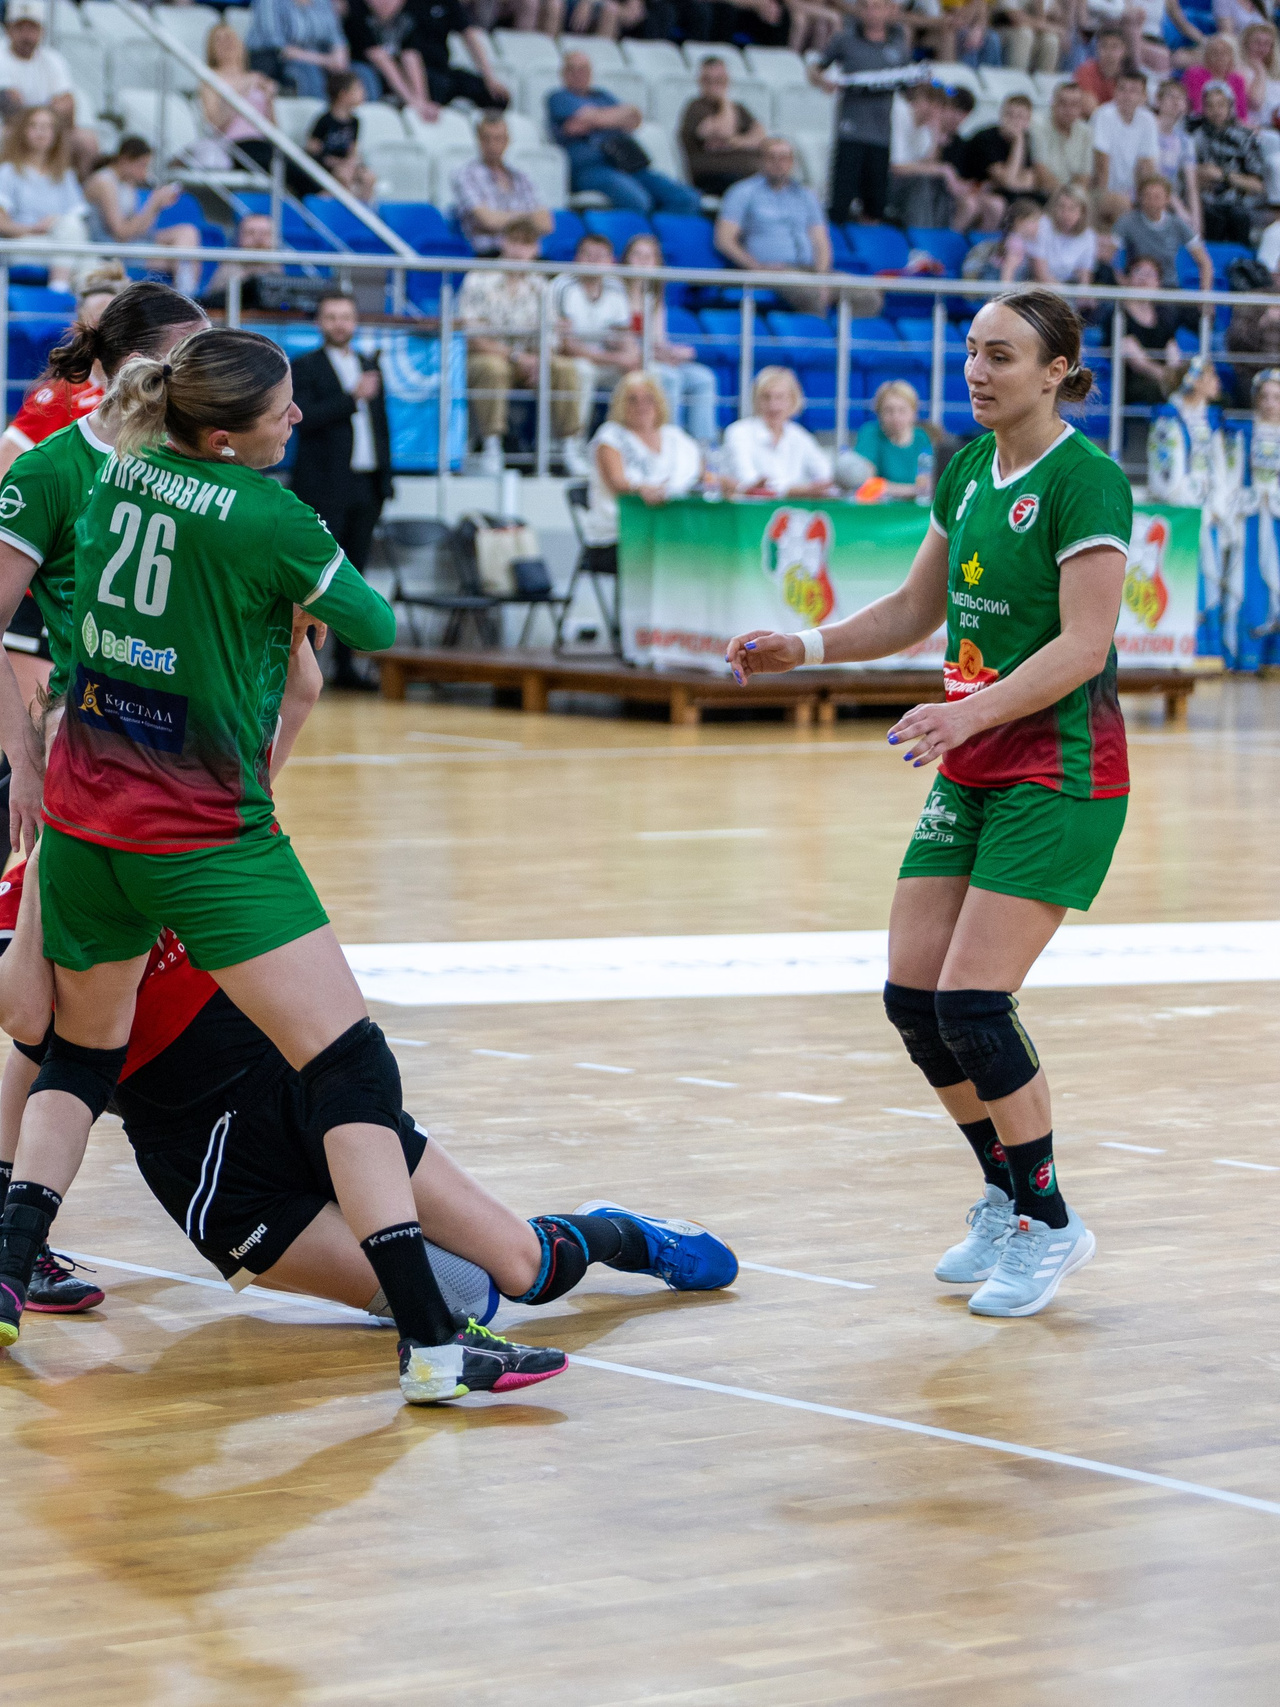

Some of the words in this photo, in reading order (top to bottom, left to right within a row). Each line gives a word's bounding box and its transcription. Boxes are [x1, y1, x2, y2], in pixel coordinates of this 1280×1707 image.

[955, 479, 977, 521] 3
[97, 501, 177, 617] 26
[951, 591, 1010, 616] МЕЛЬСКИЙ
[960, 611, 980, 629] ДСК
[102, 629, 177, 674] BelFert
[229, 1222, 268, 1260] Kempa
